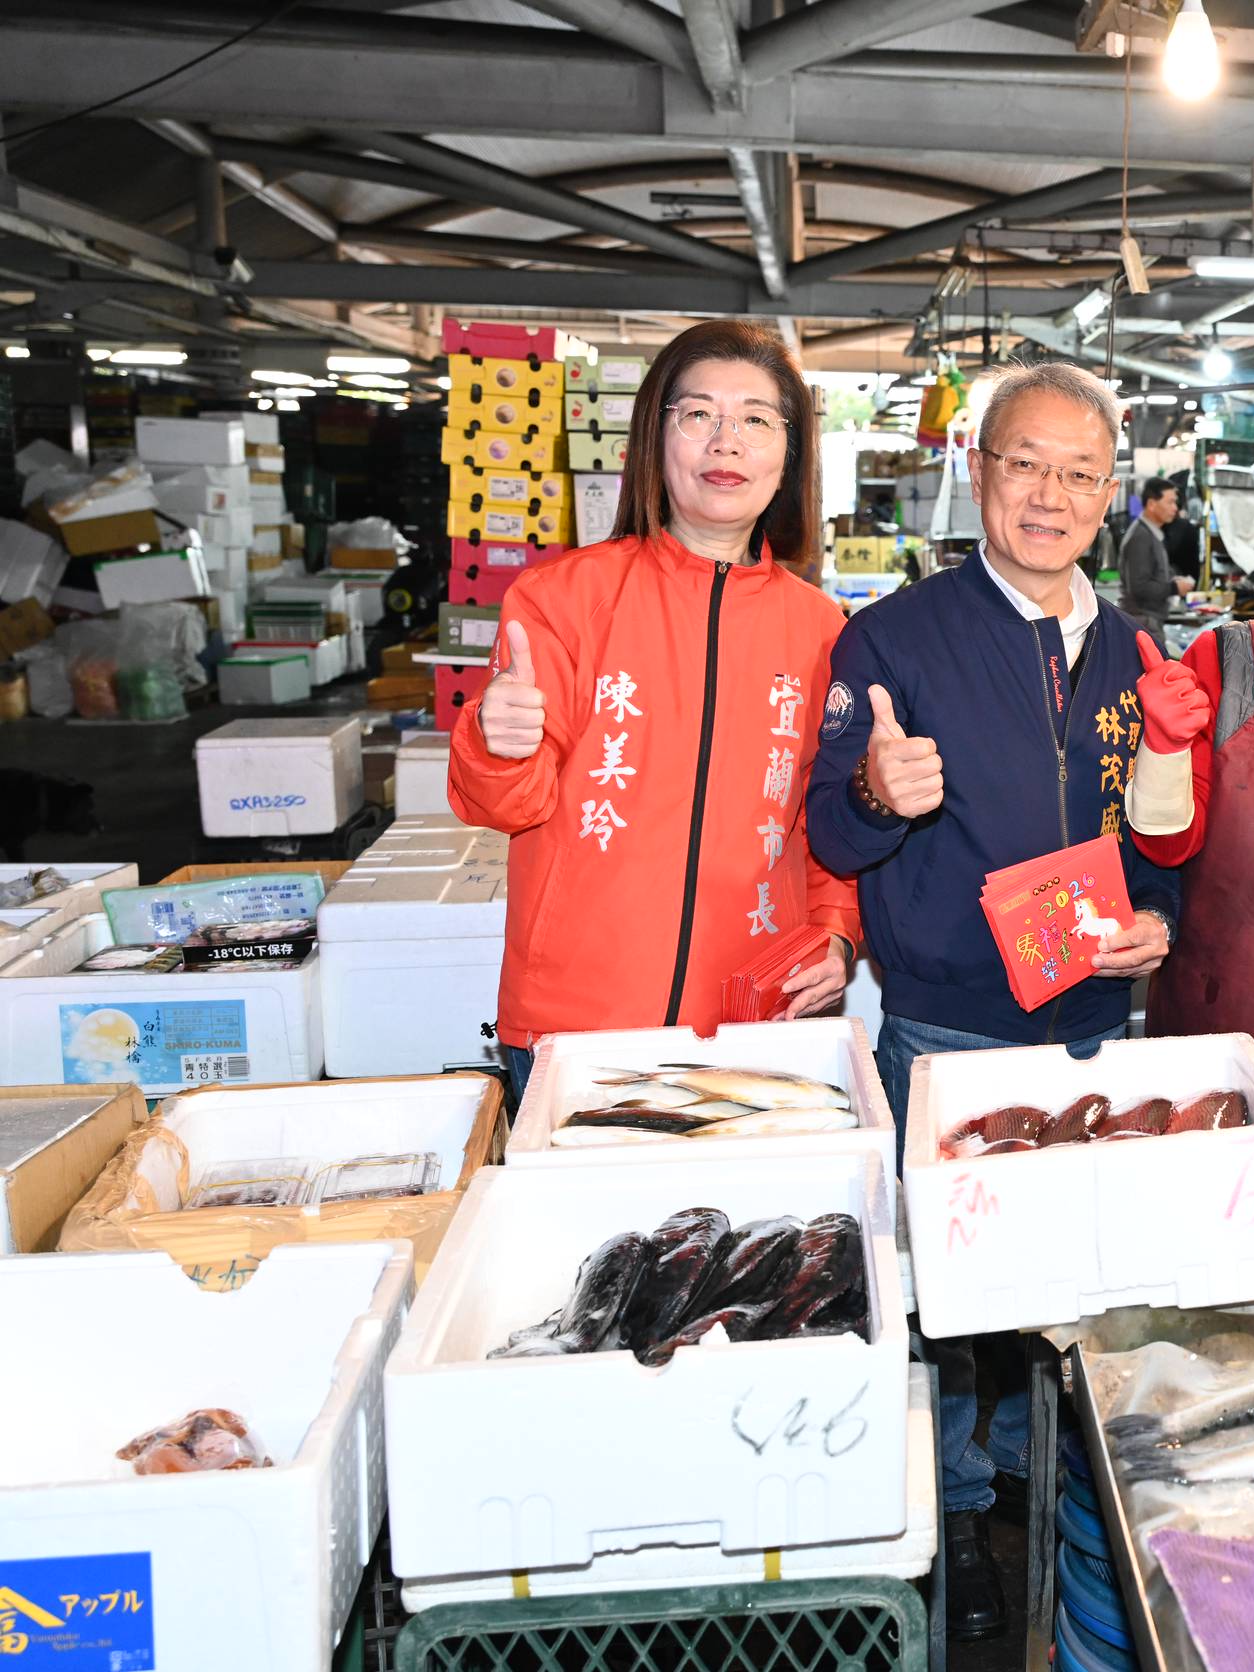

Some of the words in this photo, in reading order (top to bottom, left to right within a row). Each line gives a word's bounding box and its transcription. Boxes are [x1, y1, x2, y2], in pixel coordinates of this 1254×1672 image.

[774, 673, 801, 687] FILA
[579, 671, 644, 853] 陳美玲
[1095, 706, 1127, 843] 林茂盛
[747, 684, 804, 937] 宜蘭市長
[1040, 872, 1095, 918] 2026
[164, 1038, 242, 1051] SHIRO-KUMA
[58, 1588, 144, 1618] アップル
